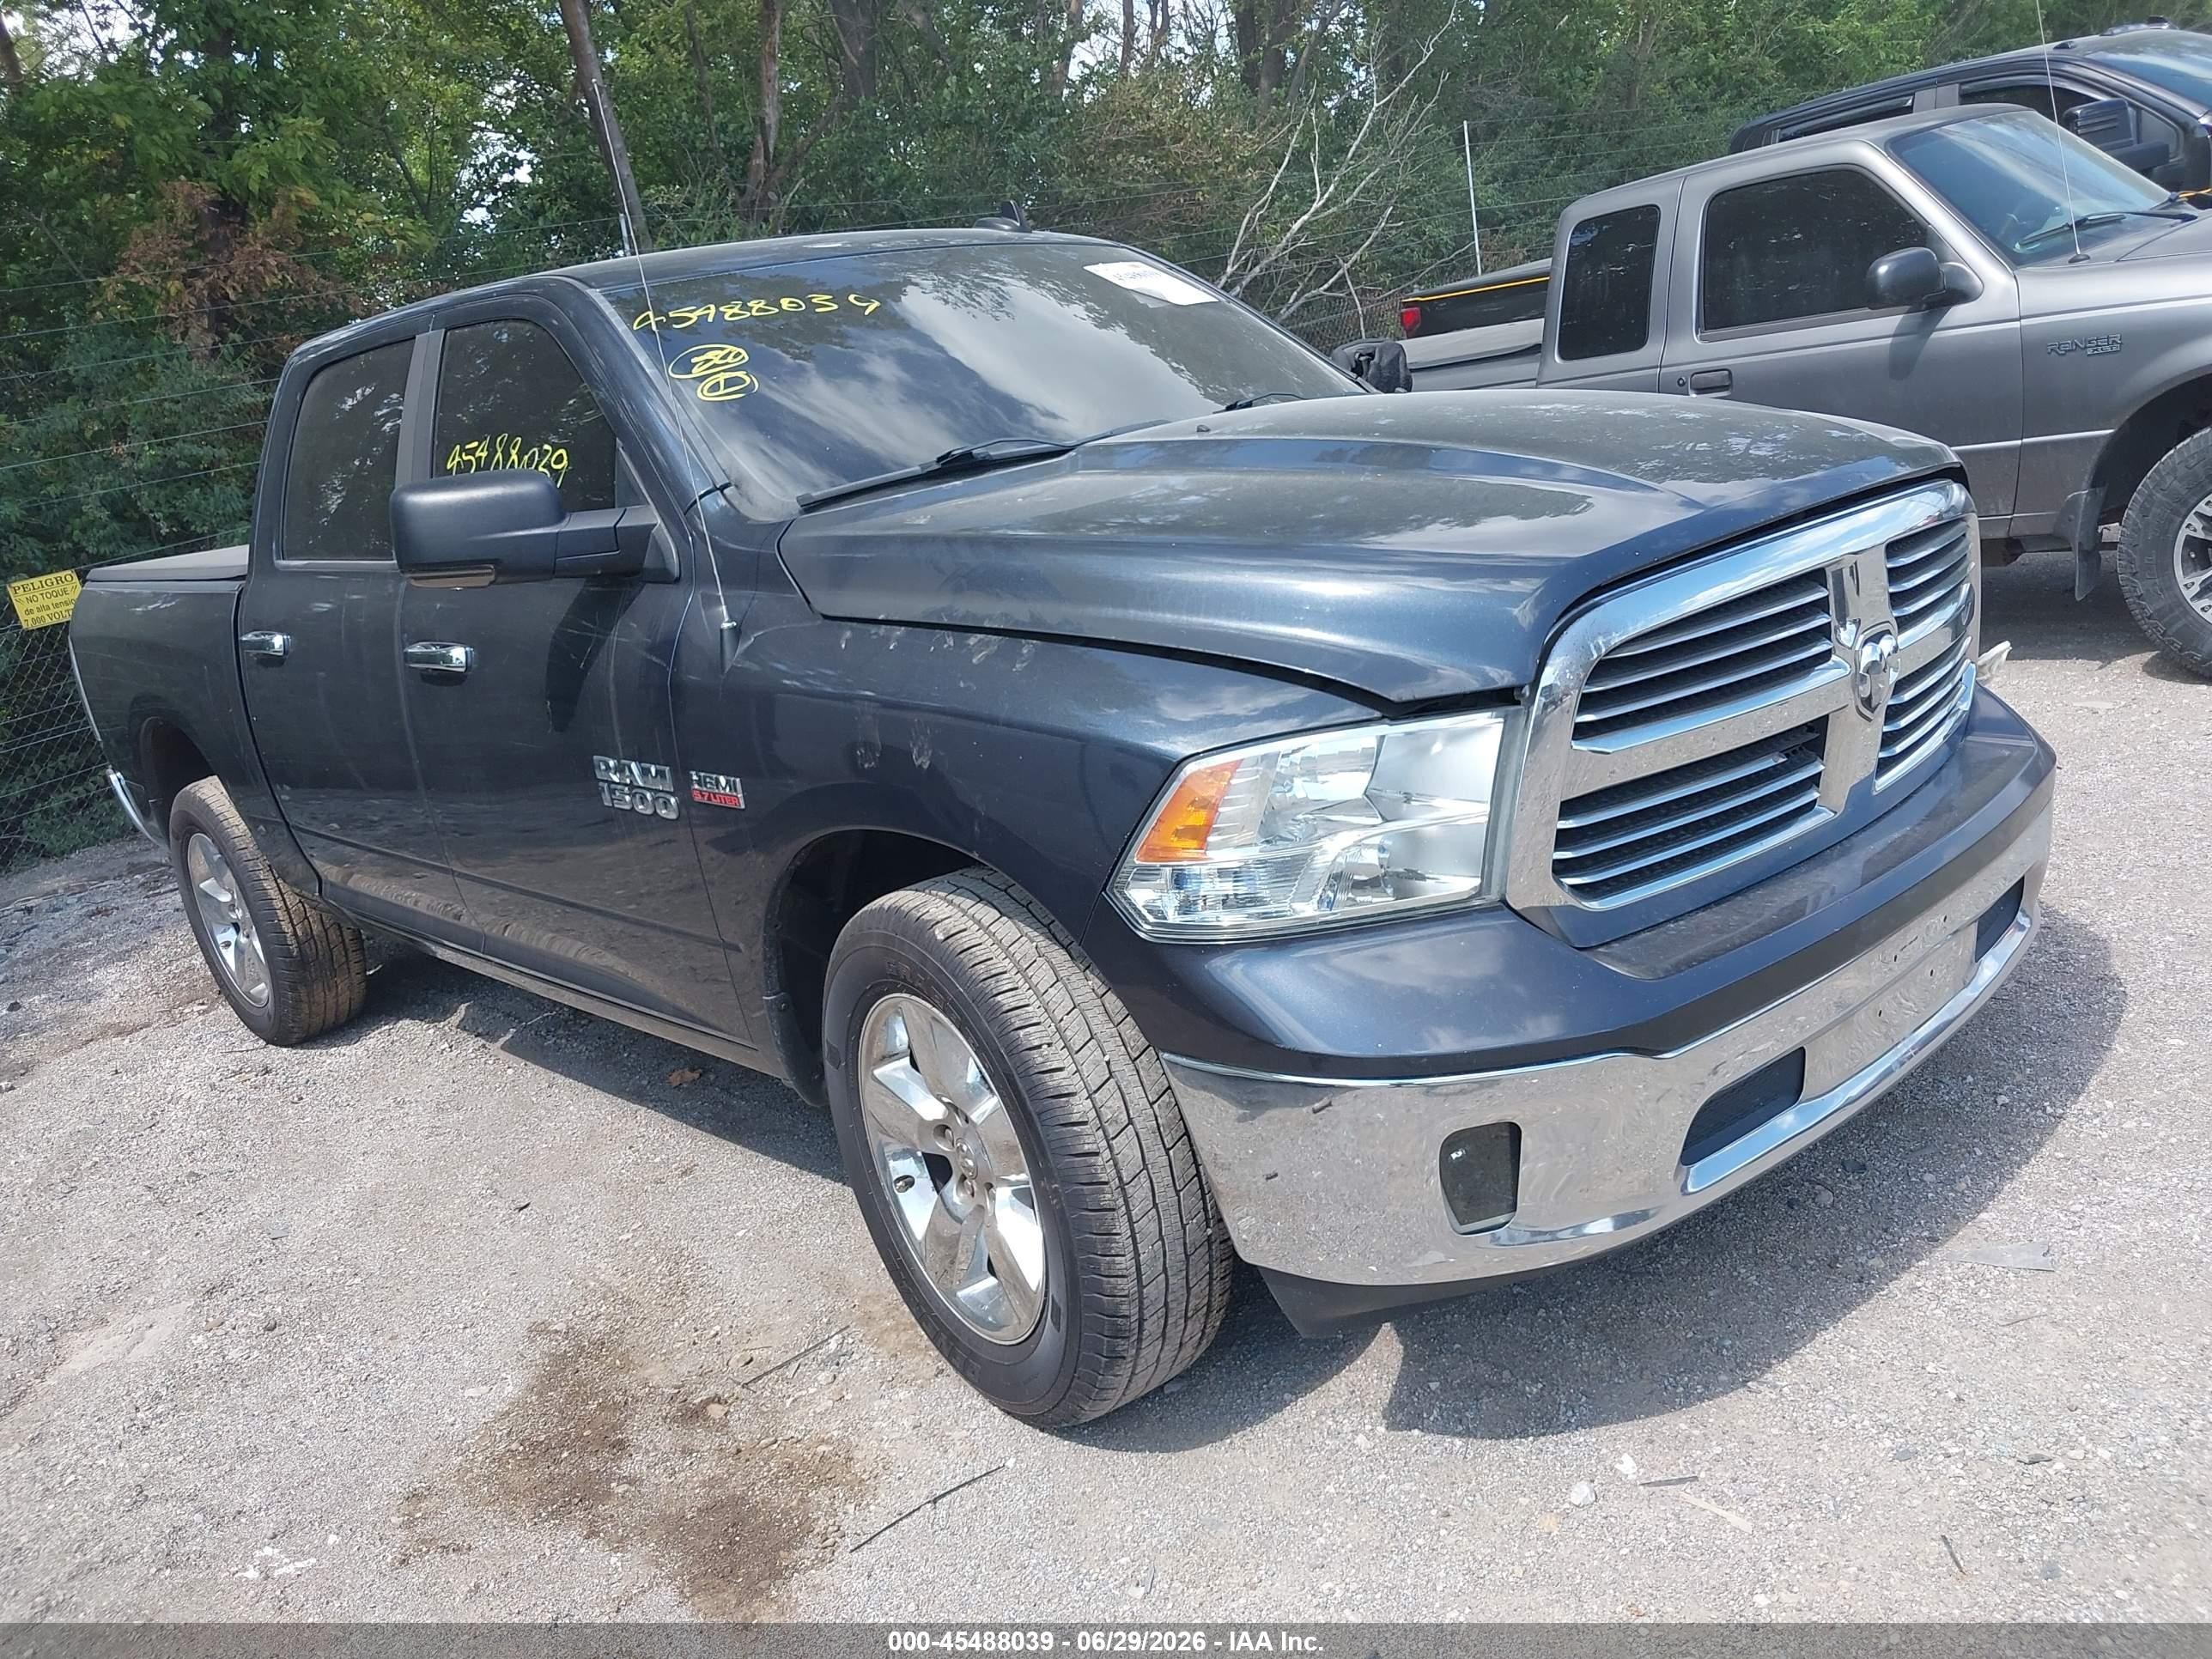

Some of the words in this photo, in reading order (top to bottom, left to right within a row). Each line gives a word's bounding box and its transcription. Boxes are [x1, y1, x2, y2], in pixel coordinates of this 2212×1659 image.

[2046, 334, 2122, 356] RANGER
[12, 574, 74, 595] PELIGRO
[26, 594, 39, 605] NO
[40, 586, 70, 601] TOQUE
[24, 607, 35, 616] de
[37, 604, 51, 613] alta
[592, 755, 674, 793] RAM
[690, 770, 743, 796] HEMI
[599, 781, 681, 820] 1500
[692, 789, 709, 801] 5.7
[710, 792, 740, 806] LITER
